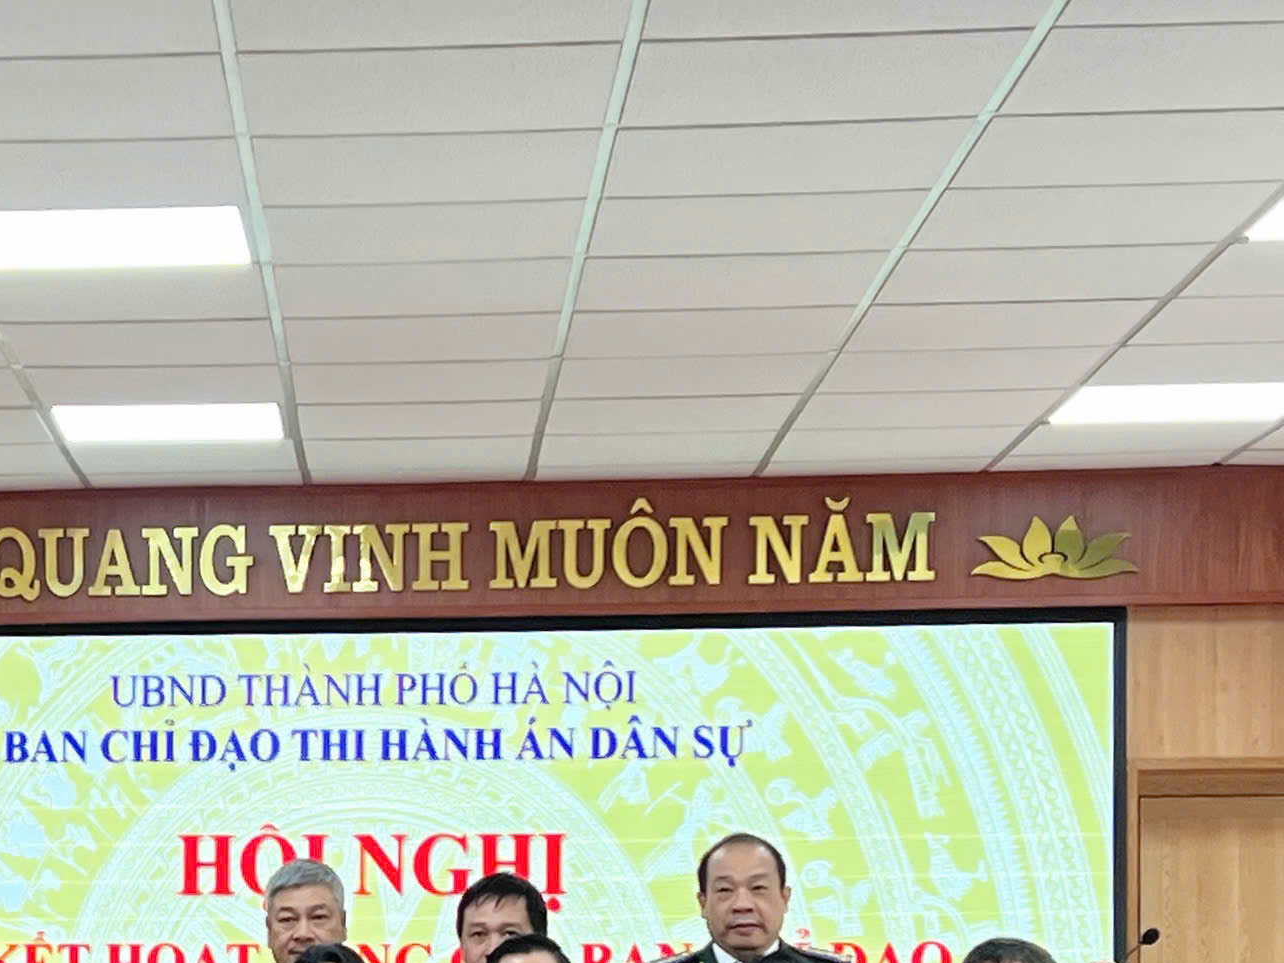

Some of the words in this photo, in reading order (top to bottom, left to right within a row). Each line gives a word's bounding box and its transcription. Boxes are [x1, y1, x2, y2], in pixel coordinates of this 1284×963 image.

[269, 522, 471, 592] VINH
[489, 497, 728, 589] MUÔN
[748, 497, 935, 584] NĂM
[111, 674, 227, 707] UBND
[238, 663, 383, 706] THÀNH
[492, 661, 549, 705] HÀ
[563, 660, 636, 710] NỘI
[5, 729, 87, 763] BAN
[100, 719, 176, 763] CHỈ
[189, 728, 281, 771] ĐẠO
[291, 729, 365, 762] THI
[380, 717, 503, 761] HÀNH
[590, 715, 679, 760] DÂN
[693, 718, 753, 768] SỰ
[353, 832, 567, 912] NGHỊ
